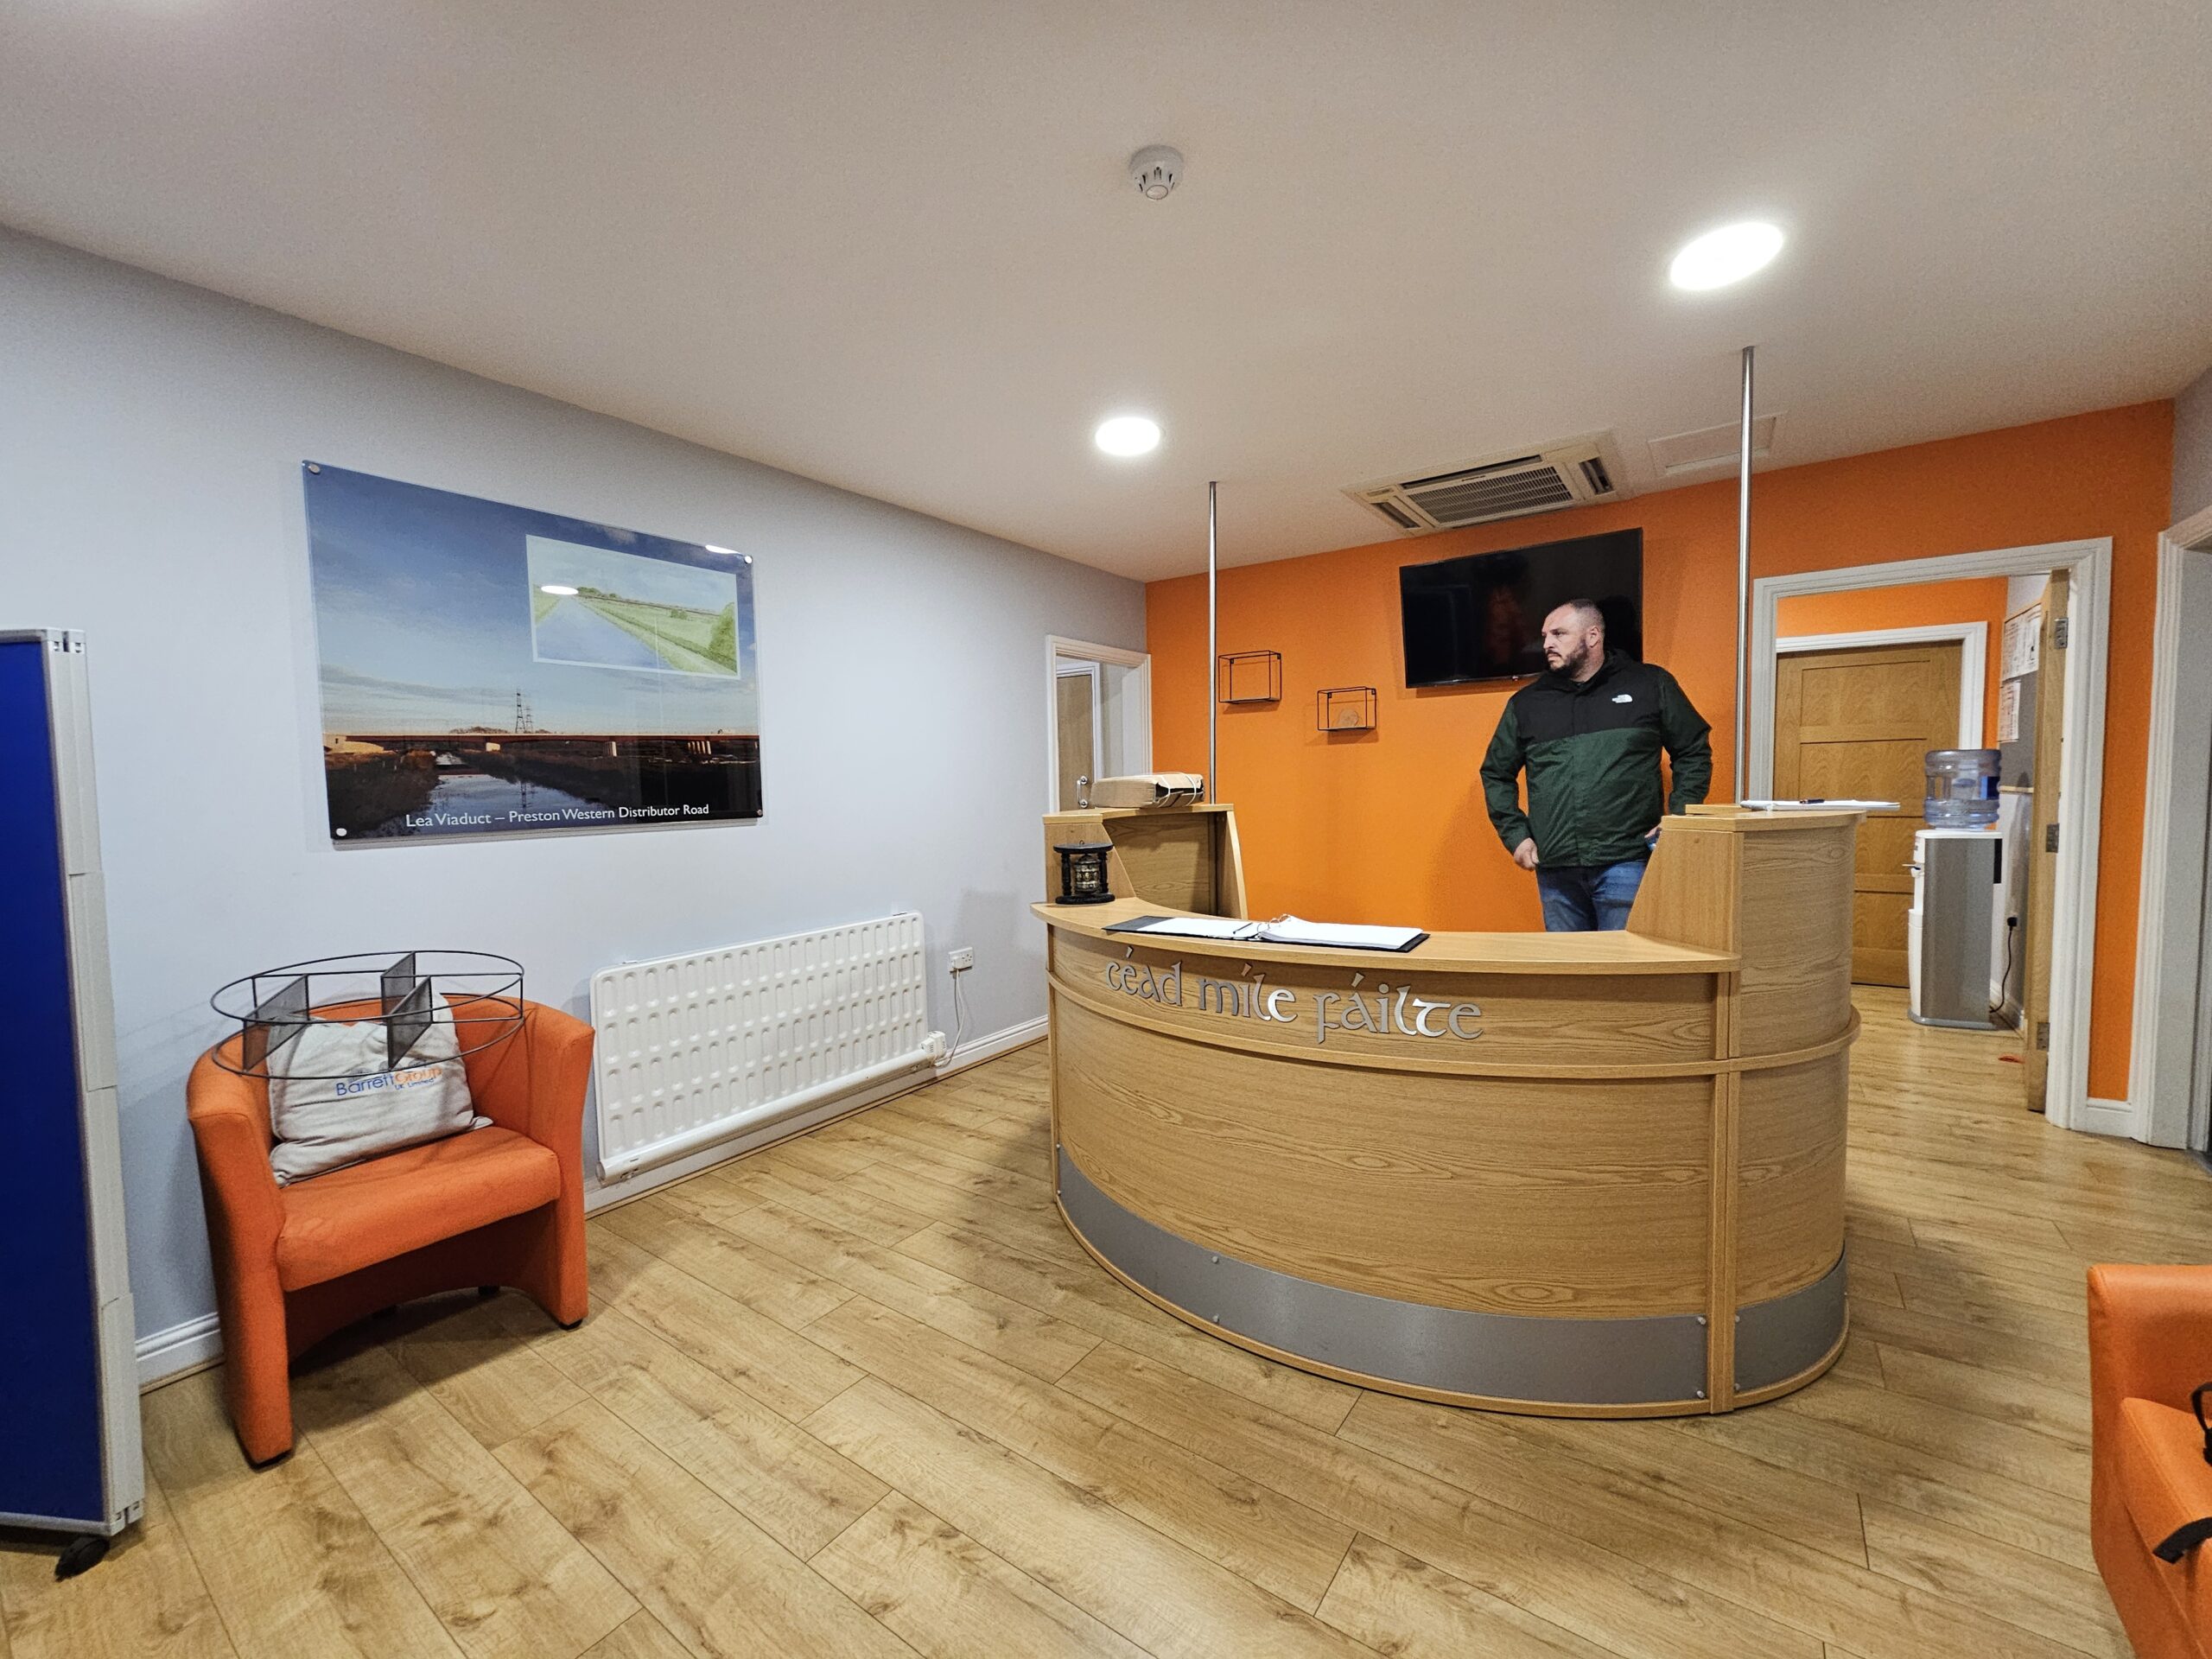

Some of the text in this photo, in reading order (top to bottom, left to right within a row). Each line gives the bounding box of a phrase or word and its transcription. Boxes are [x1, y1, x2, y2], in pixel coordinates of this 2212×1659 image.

[405, 814, 434, 828] Lea
[435, 812, 492, 826] Viaduct
[508, 810, 561, 823] Preston
[562, 807, 615, 820] Western
[619, 805, 680, 818] Distributor
[683, 804, 710, 816] Road
[1105, 945, 1484, 1045] céad míle fáilte
